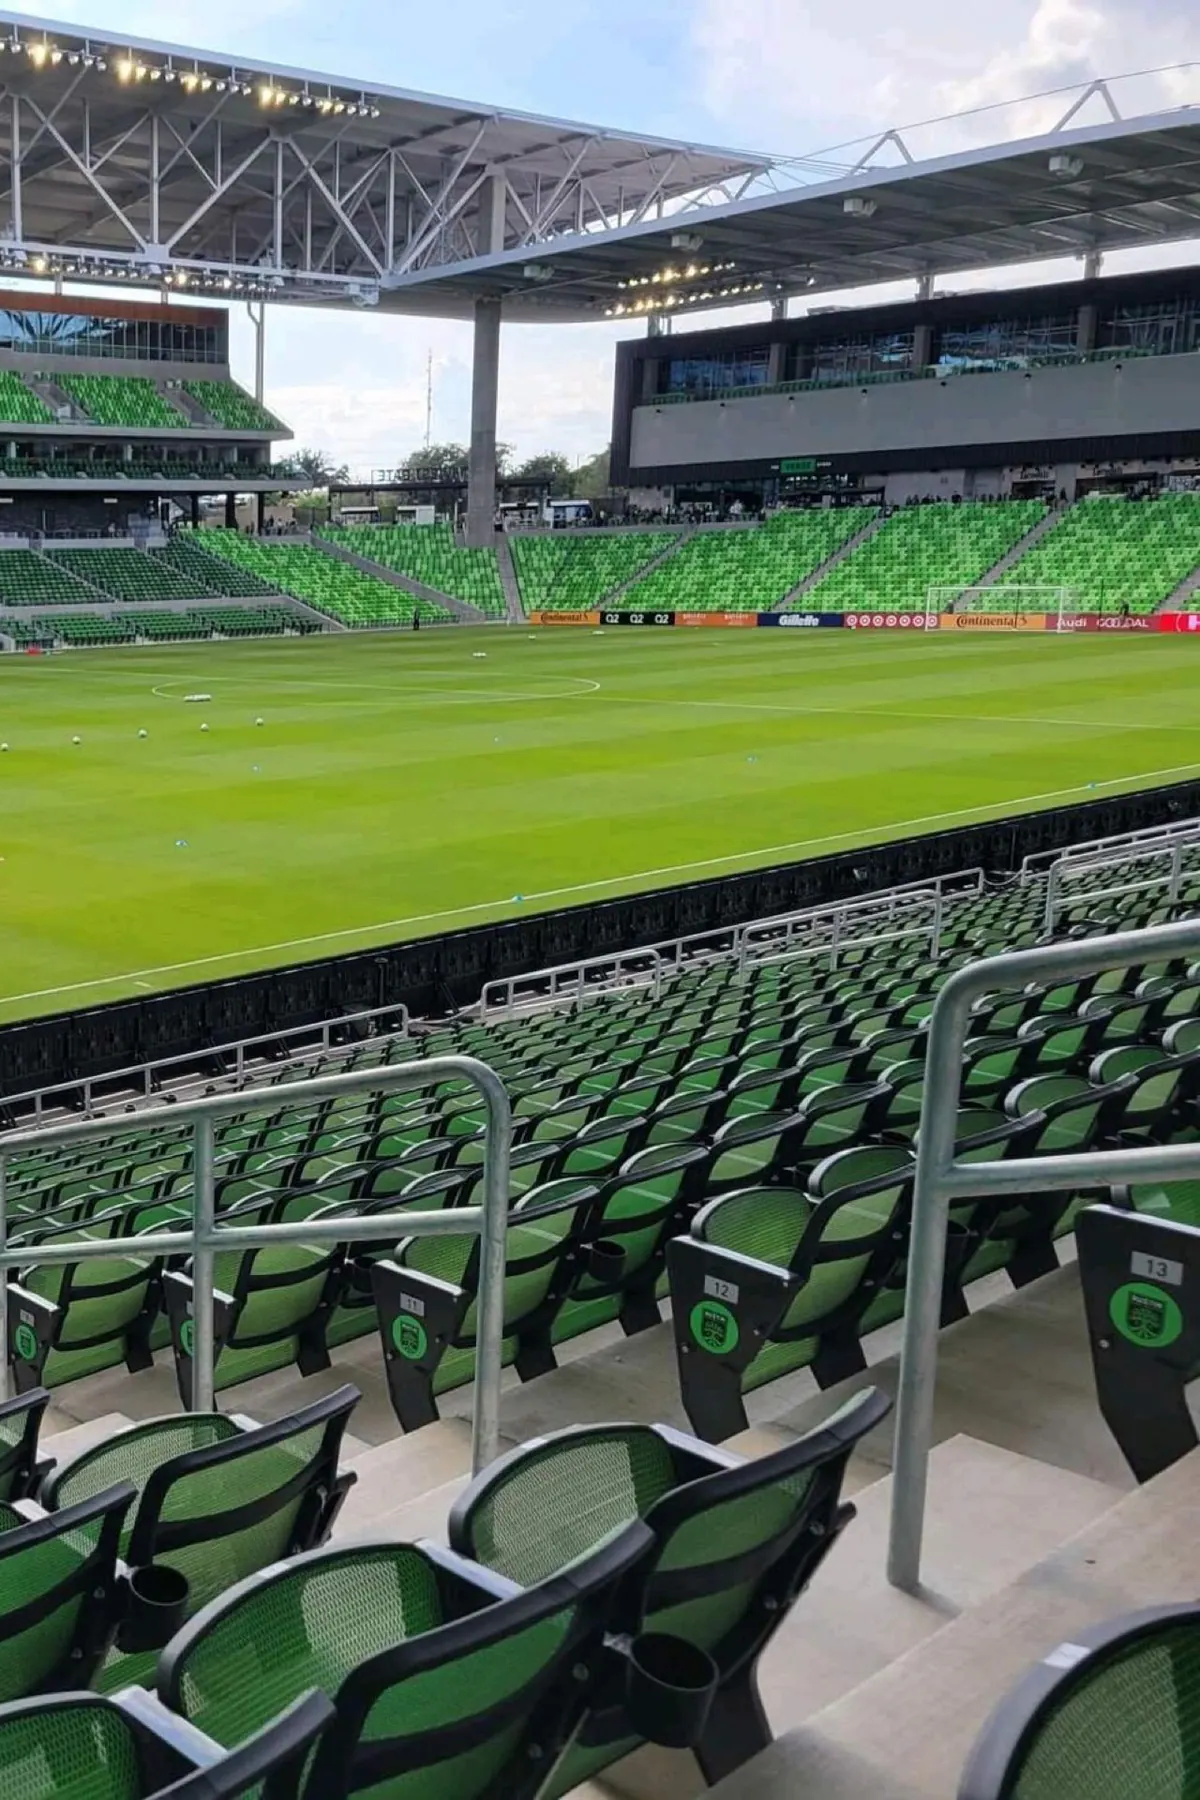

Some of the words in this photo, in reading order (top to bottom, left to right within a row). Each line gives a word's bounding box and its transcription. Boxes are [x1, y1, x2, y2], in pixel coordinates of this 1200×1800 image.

[540, 612, 582, 623] Continental
[605, 614, 619, 624] Q2
[629, 614, 645, 624] Q2
[654, 614, 670, 624] Q2
[779, 614, 819, 626] Gillette
[1057, 617, 1087, 628] Audi
[1147, 1259, 1168, 1277] 13
[715, 1282, 729, 1298] 12
